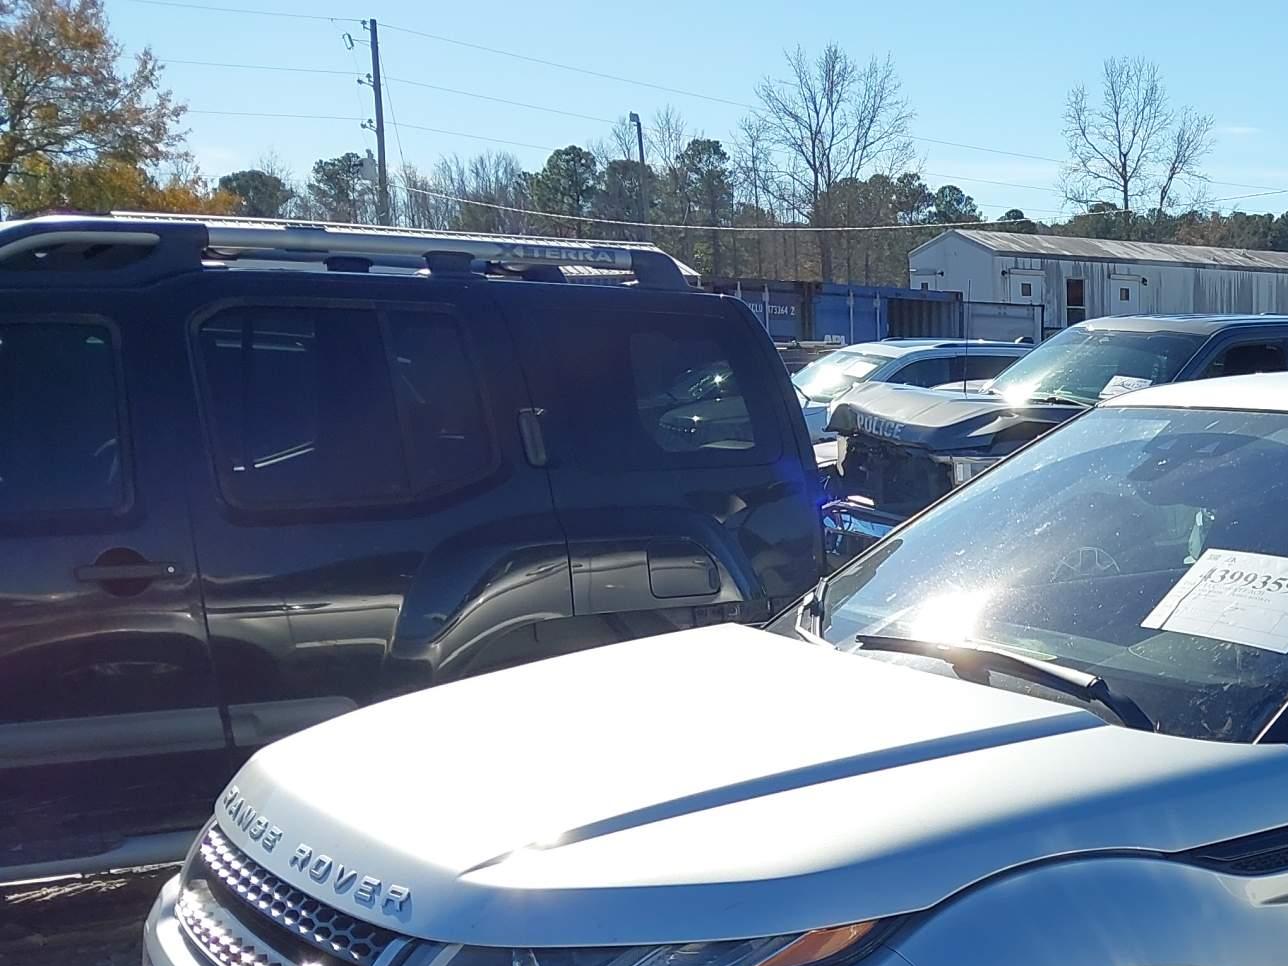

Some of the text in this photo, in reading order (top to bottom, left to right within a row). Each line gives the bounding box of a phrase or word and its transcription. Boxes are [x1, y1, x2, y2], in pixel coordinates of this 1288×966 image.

[498, 243, 614, 262] XTERRA
[856, 412, 905, 440] POLICE
[223, 785, 412, 914] RANGE ROVER
